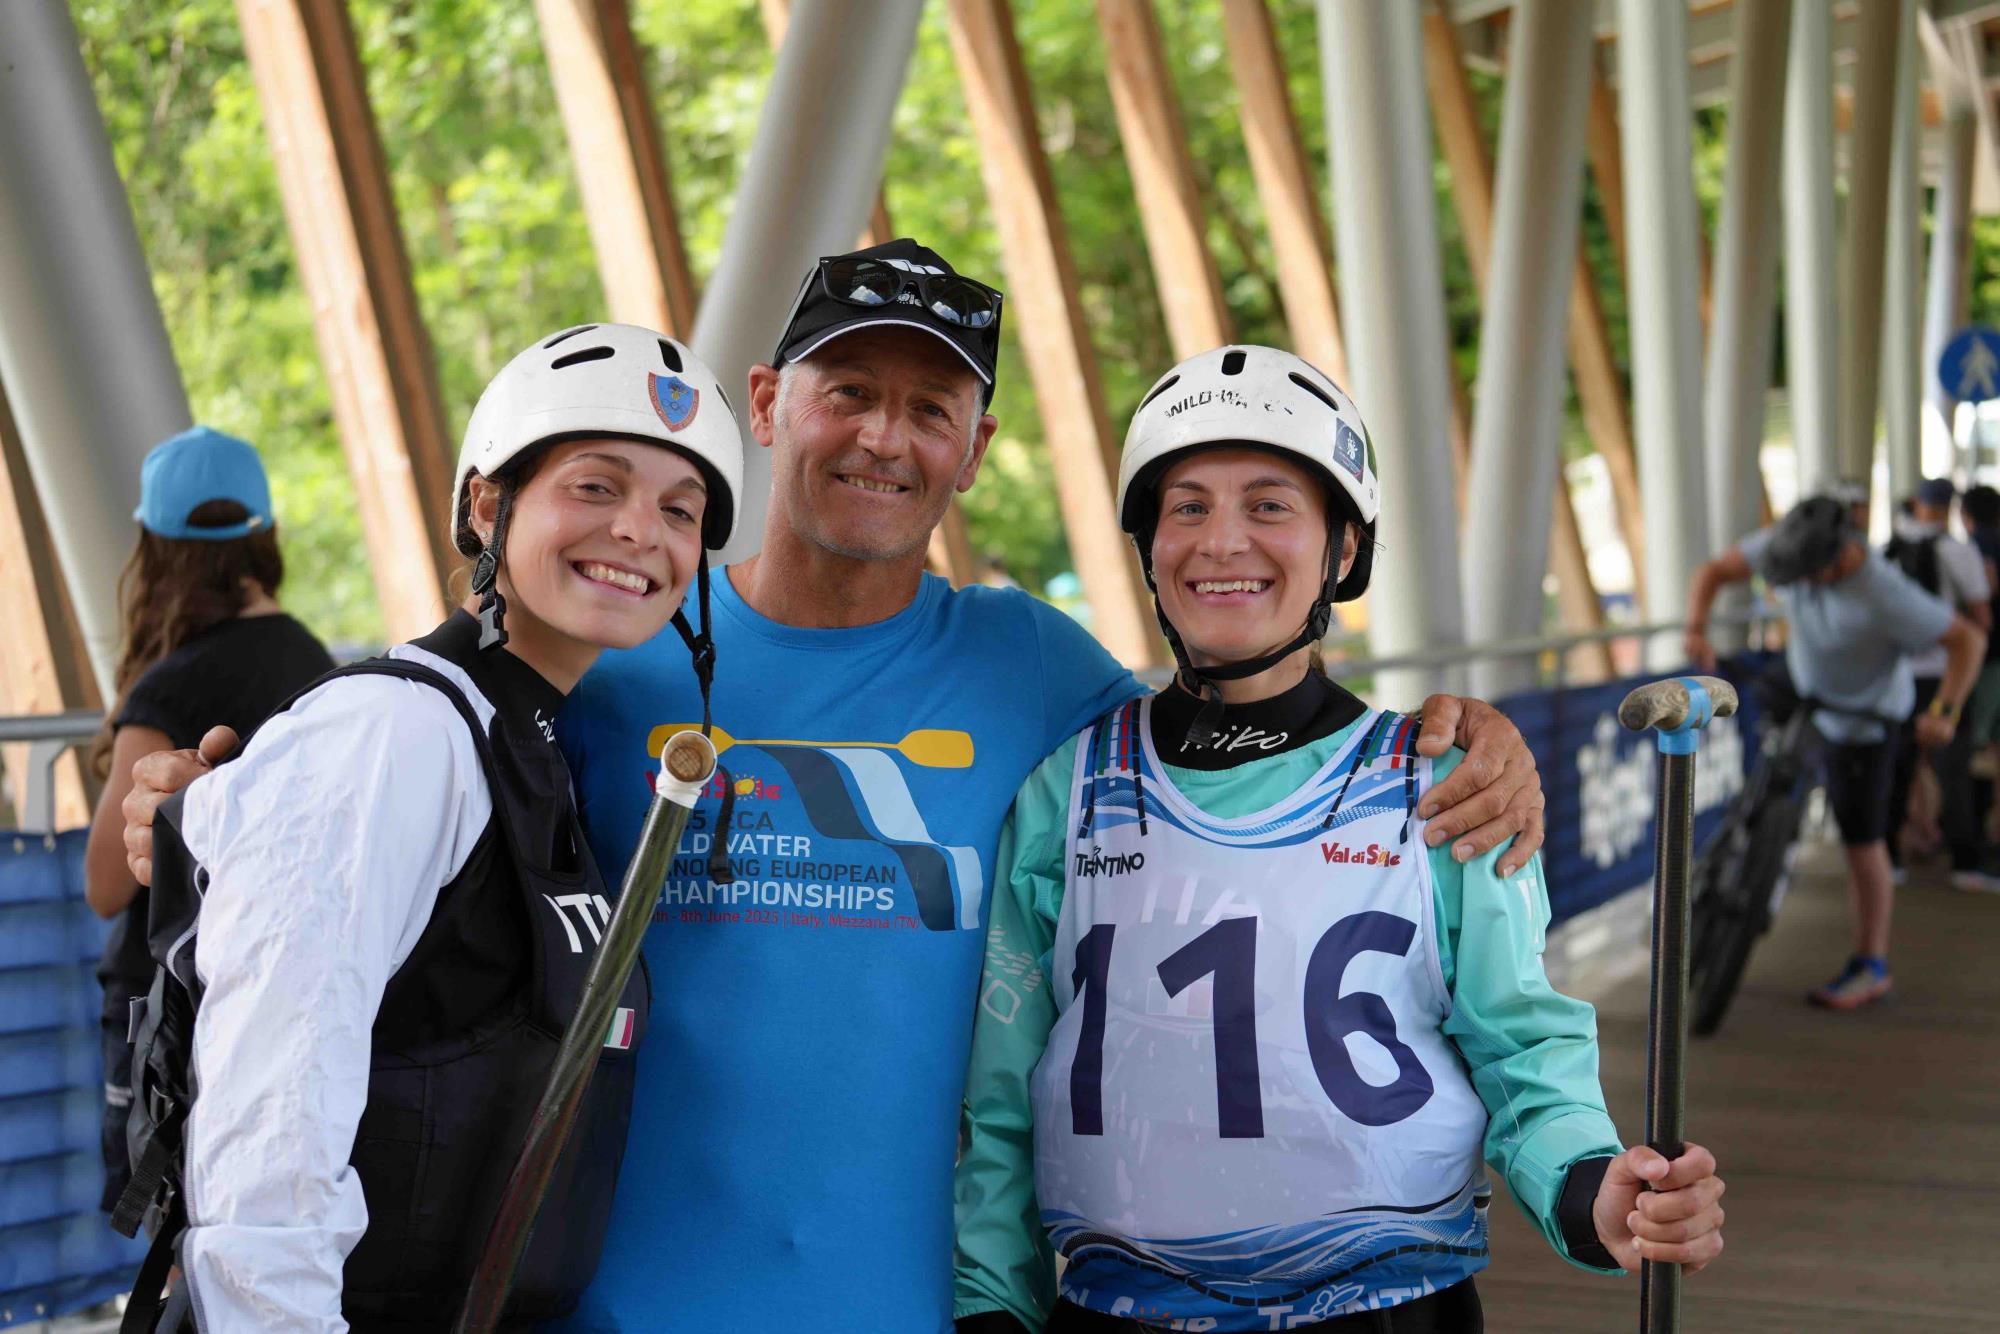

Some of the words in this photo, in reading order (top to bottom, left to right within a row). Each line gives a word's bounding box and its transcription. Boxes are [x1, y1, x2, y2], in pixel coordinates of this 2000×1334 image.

[731, 811, 774, 831] CA
[1321, 842, 1350, 864] Val
[771, 860, 896, 884] EUROPEAN
[656, 880, 895, 911] HAMPIONSHIPS
[706, 910, 741, 923] June
[743, 909, 779, 924] 2025
[829, 913, 890, 929] Mezzana
[1070, 911, 1434, 1138] 116
